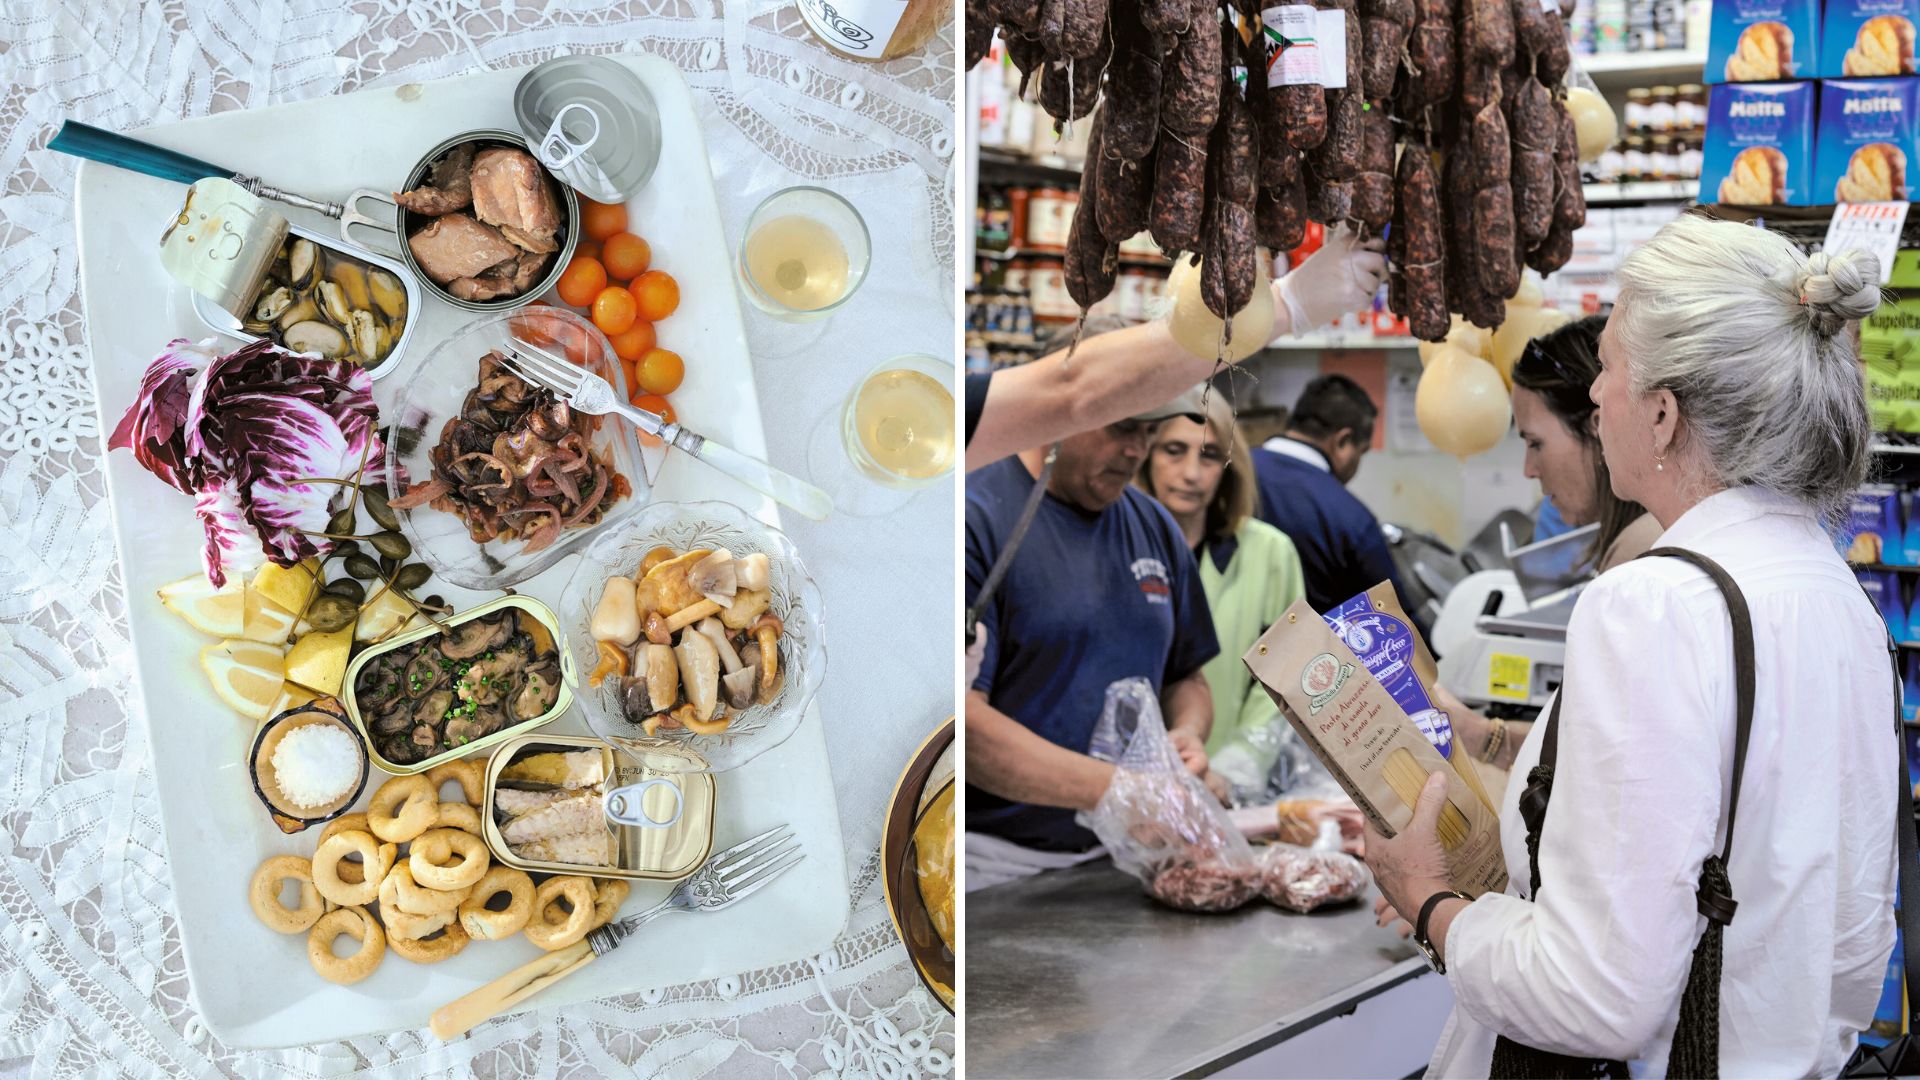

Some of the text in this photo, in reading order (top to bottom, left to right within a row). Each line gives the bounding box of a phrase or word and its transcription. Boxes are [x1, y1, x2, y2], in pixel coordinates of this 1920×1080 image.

[1728, 101, 1786, 118] Motta
[1843, 97, 1903, 115] Motta
[1320, 714, 1341, 734] Pasta
[1341, 700, 1369, 732] di semola
[1343, 703, 1381, 748] di grano duro
